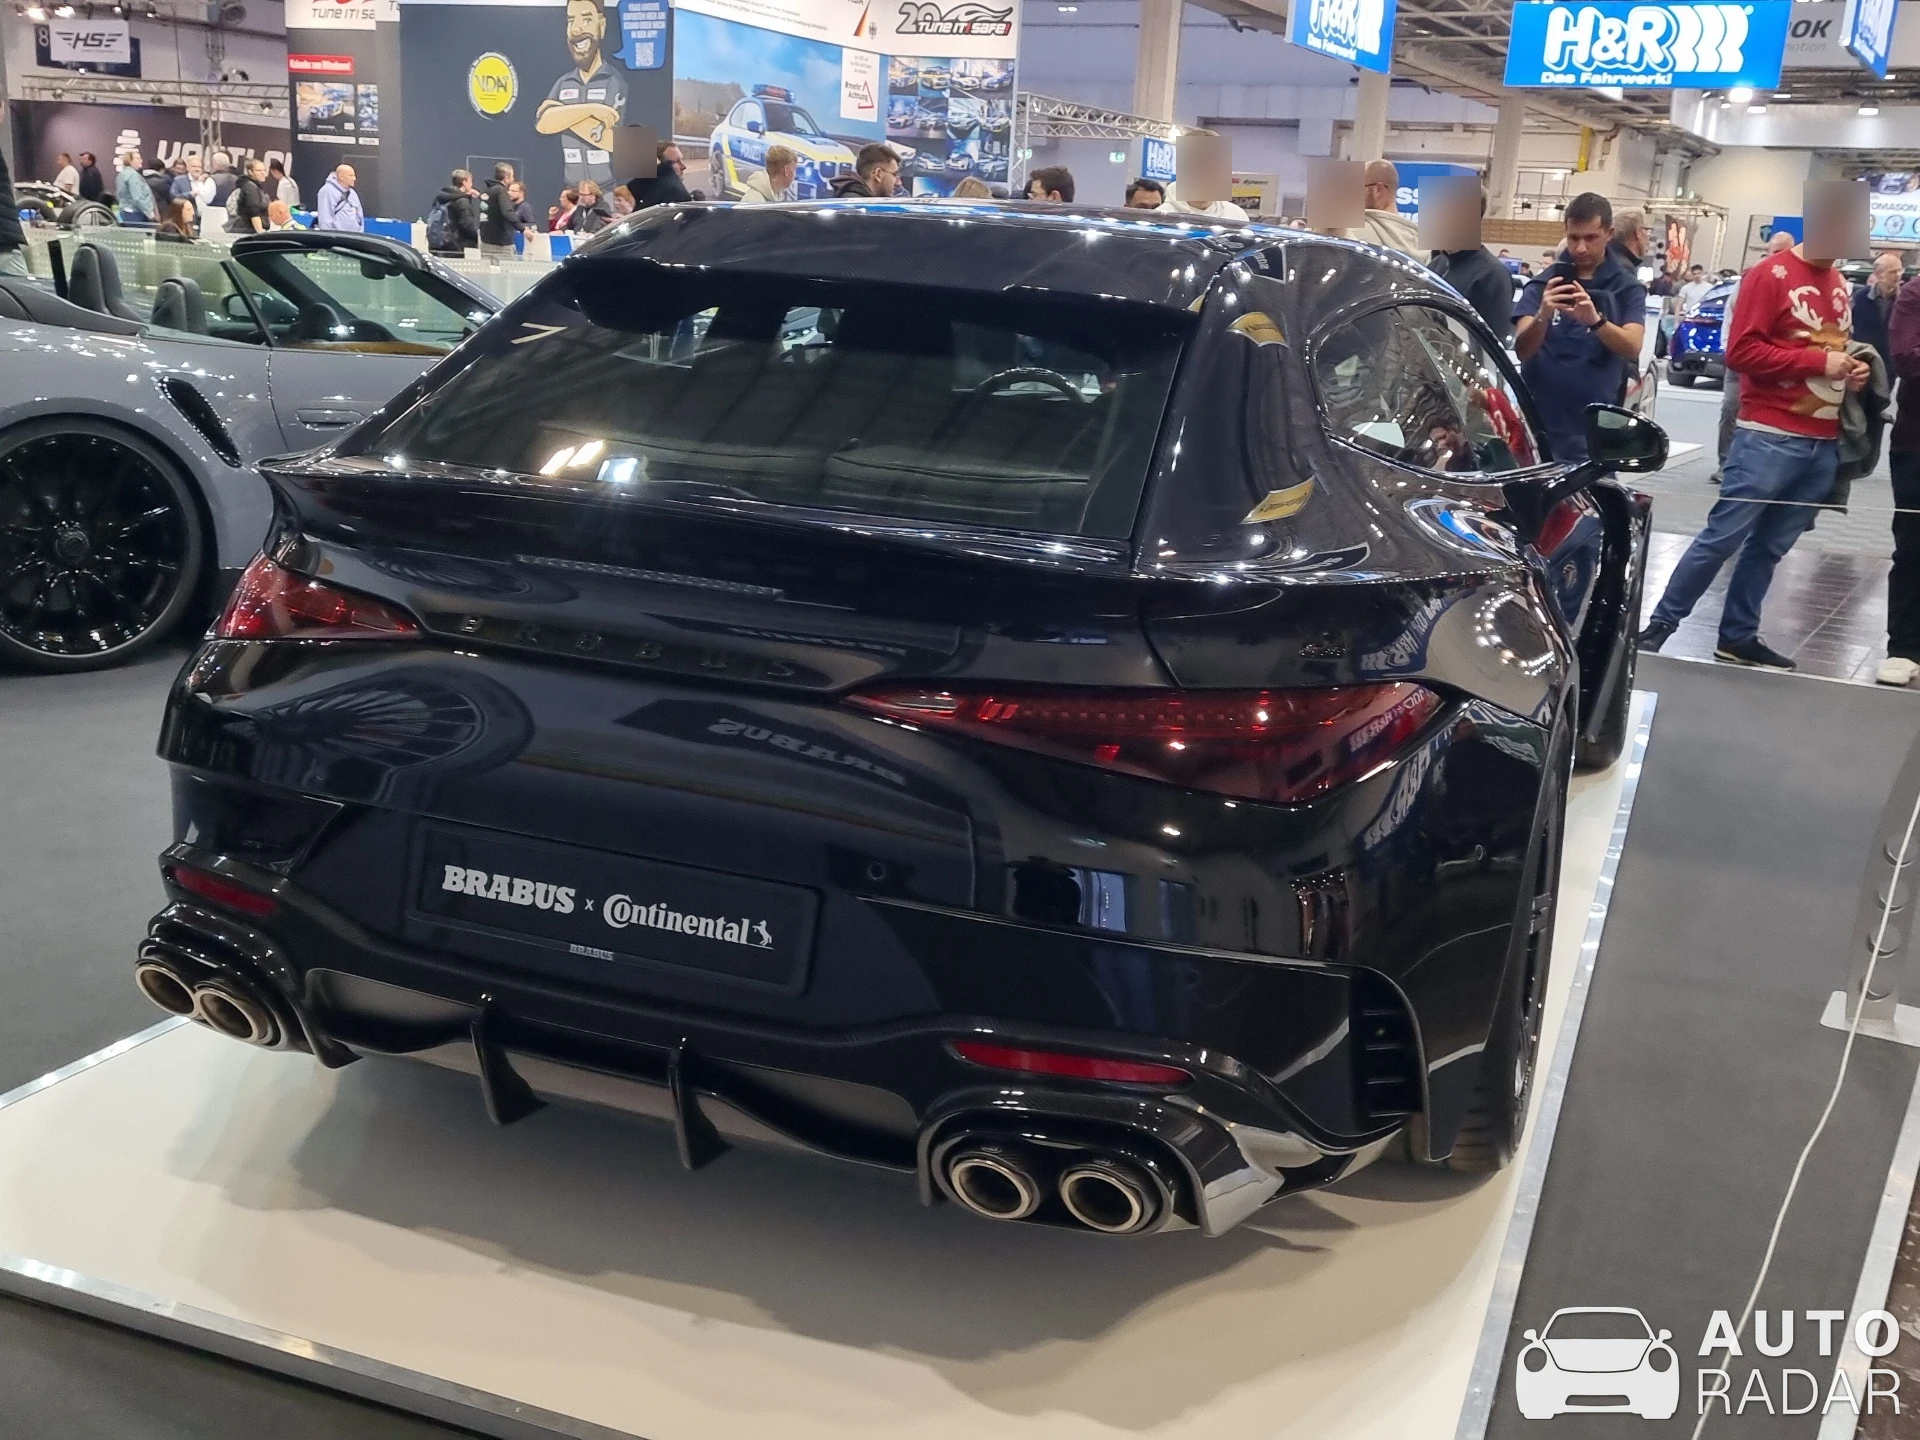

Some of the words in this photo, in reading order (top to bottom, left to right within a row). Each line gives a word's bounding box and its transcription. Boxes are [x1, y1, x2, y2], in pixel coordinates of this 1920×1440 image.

[896, 2, 941, 34] 20
[917, 21, 952, 34] TUNE
[970, 21, 1012, 35] SAFE!
[1789, 20, 1833, 38] OK
[1543, 6, 1678, 73] H&R
[1540, 71, 1577, 84] Das
[1580, 72, 1673, 85] Fahrwerk!
[1870, 202, 1917, 212] OMASON
[442, 864, 576, 914] BRABUS
[603, 893, 749, 945] Continental
[569, 943, 614, 962] BRABUS
